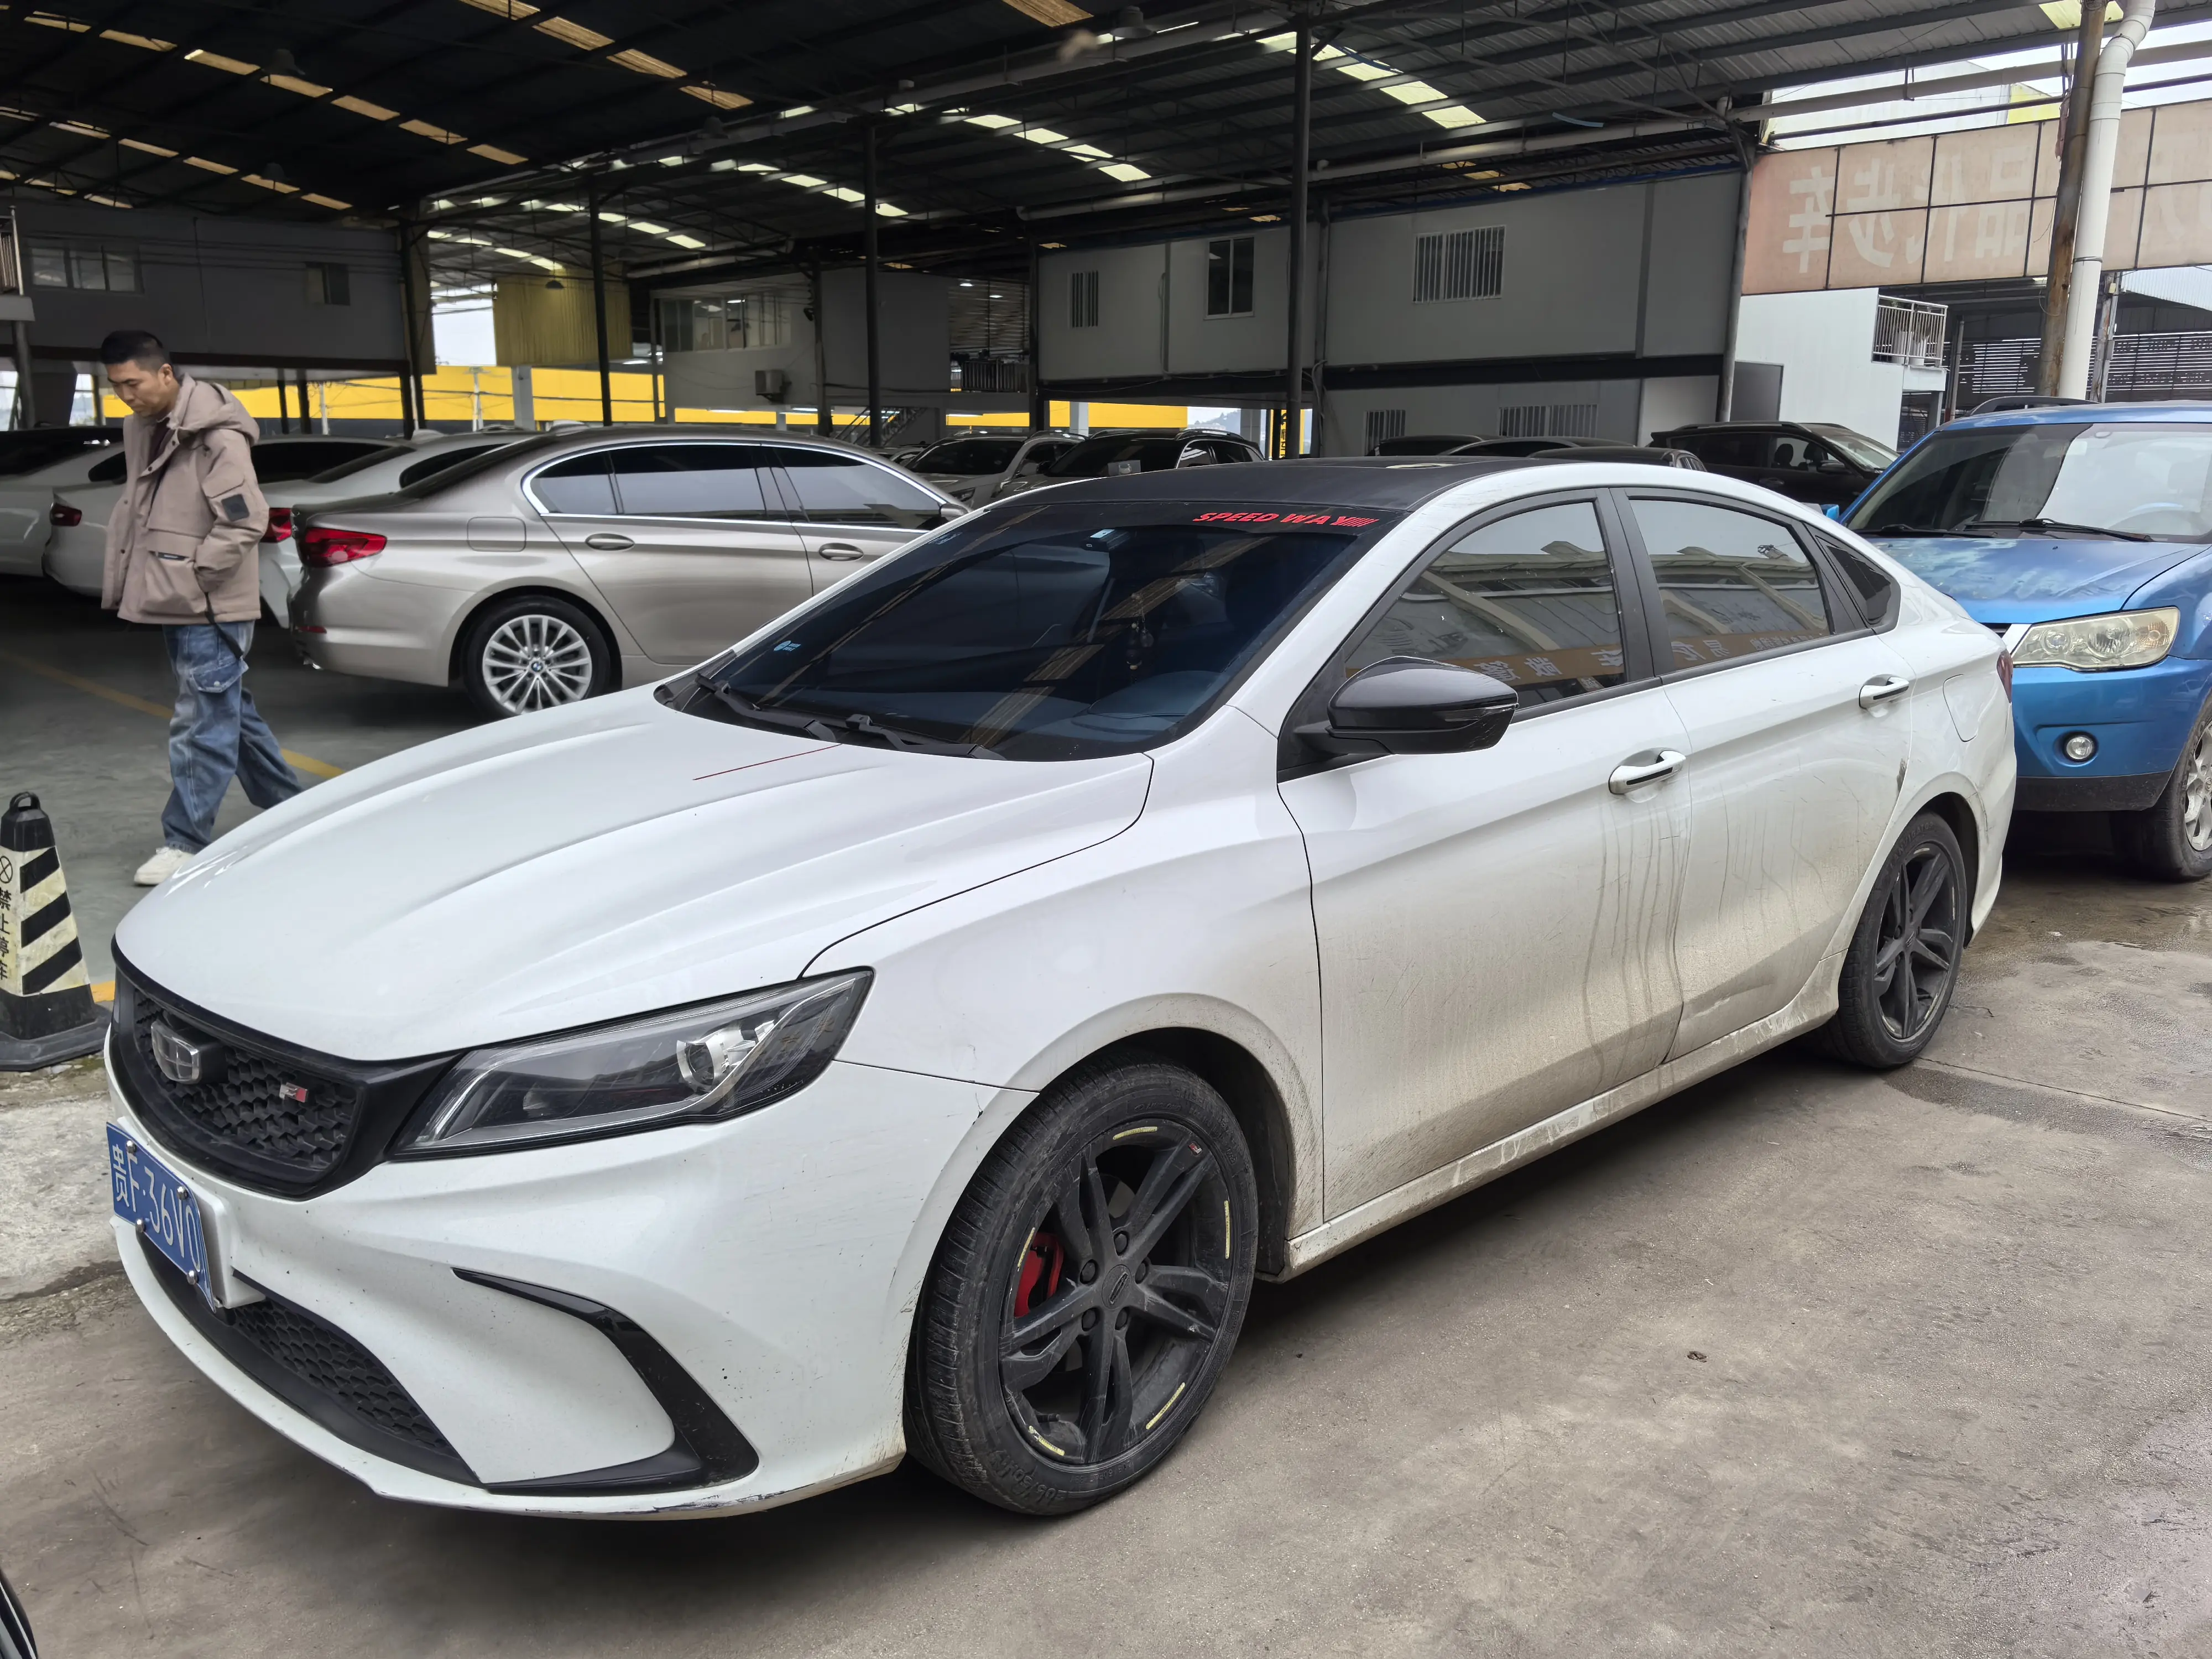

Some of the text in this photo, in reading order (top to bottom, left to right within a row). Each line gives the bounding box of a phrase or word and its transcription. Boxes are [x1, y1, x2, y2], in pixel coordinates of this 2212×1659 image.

[1192, 512, 1379, 527] SPEED WAY
[112, 1144, 201, 1272] 贵F·36V0
